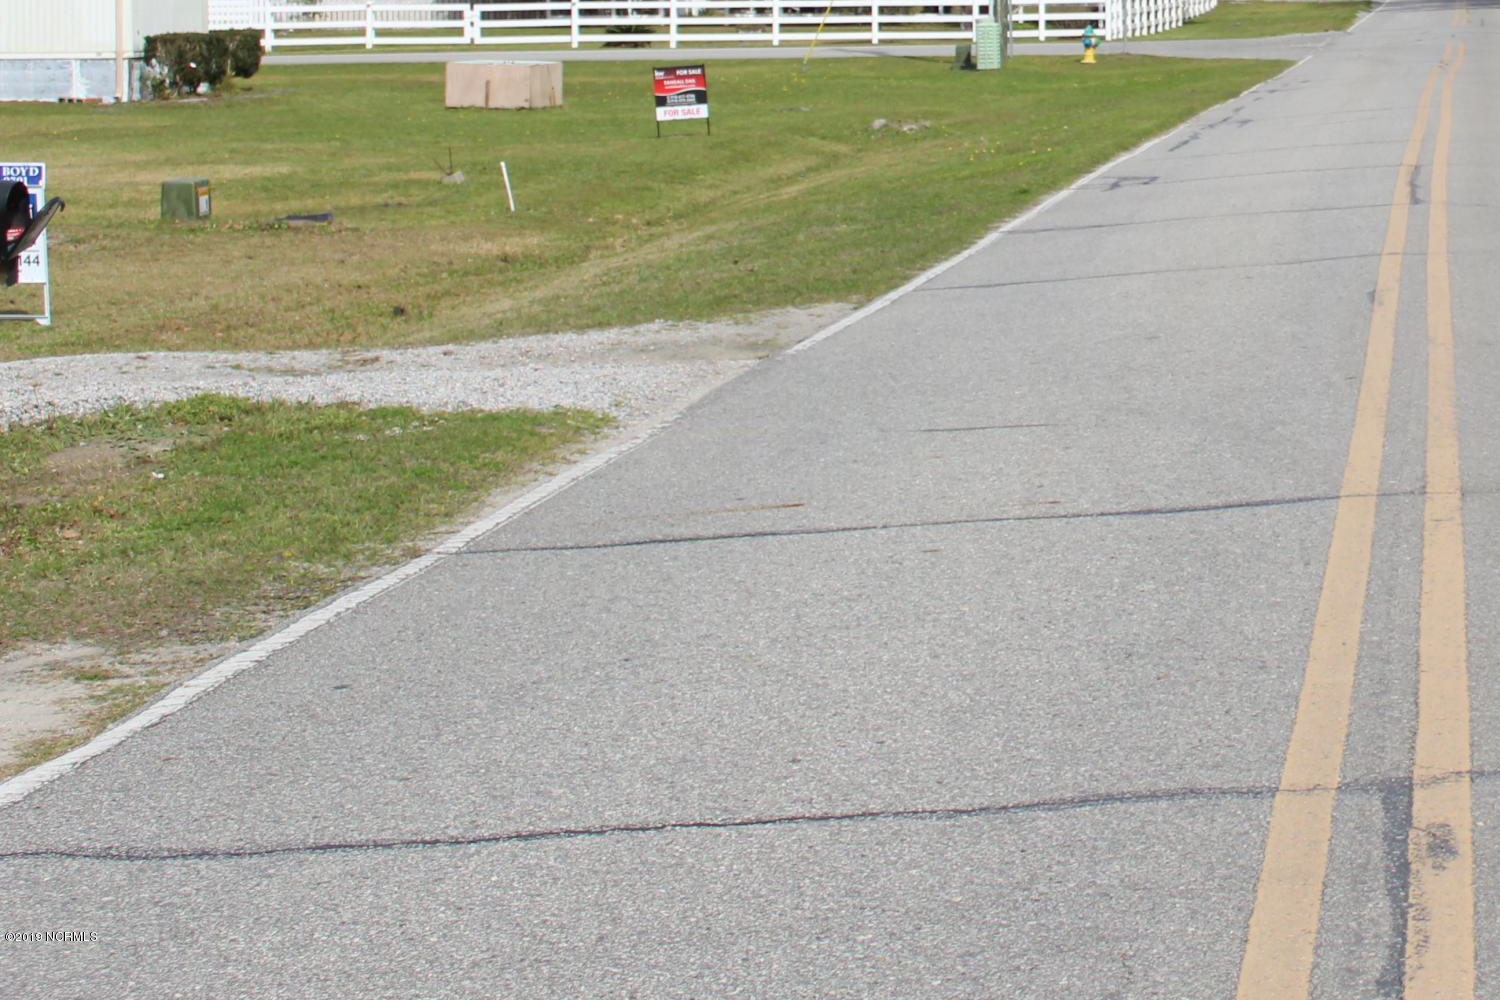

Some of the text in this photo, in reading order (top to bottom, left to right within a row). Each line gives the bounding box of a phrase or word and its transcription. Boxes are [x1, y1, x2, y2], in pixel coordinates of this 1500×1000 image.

[664, 107, 702, 118] FOR SALE
[2, 166, 39, 177] BOYD
